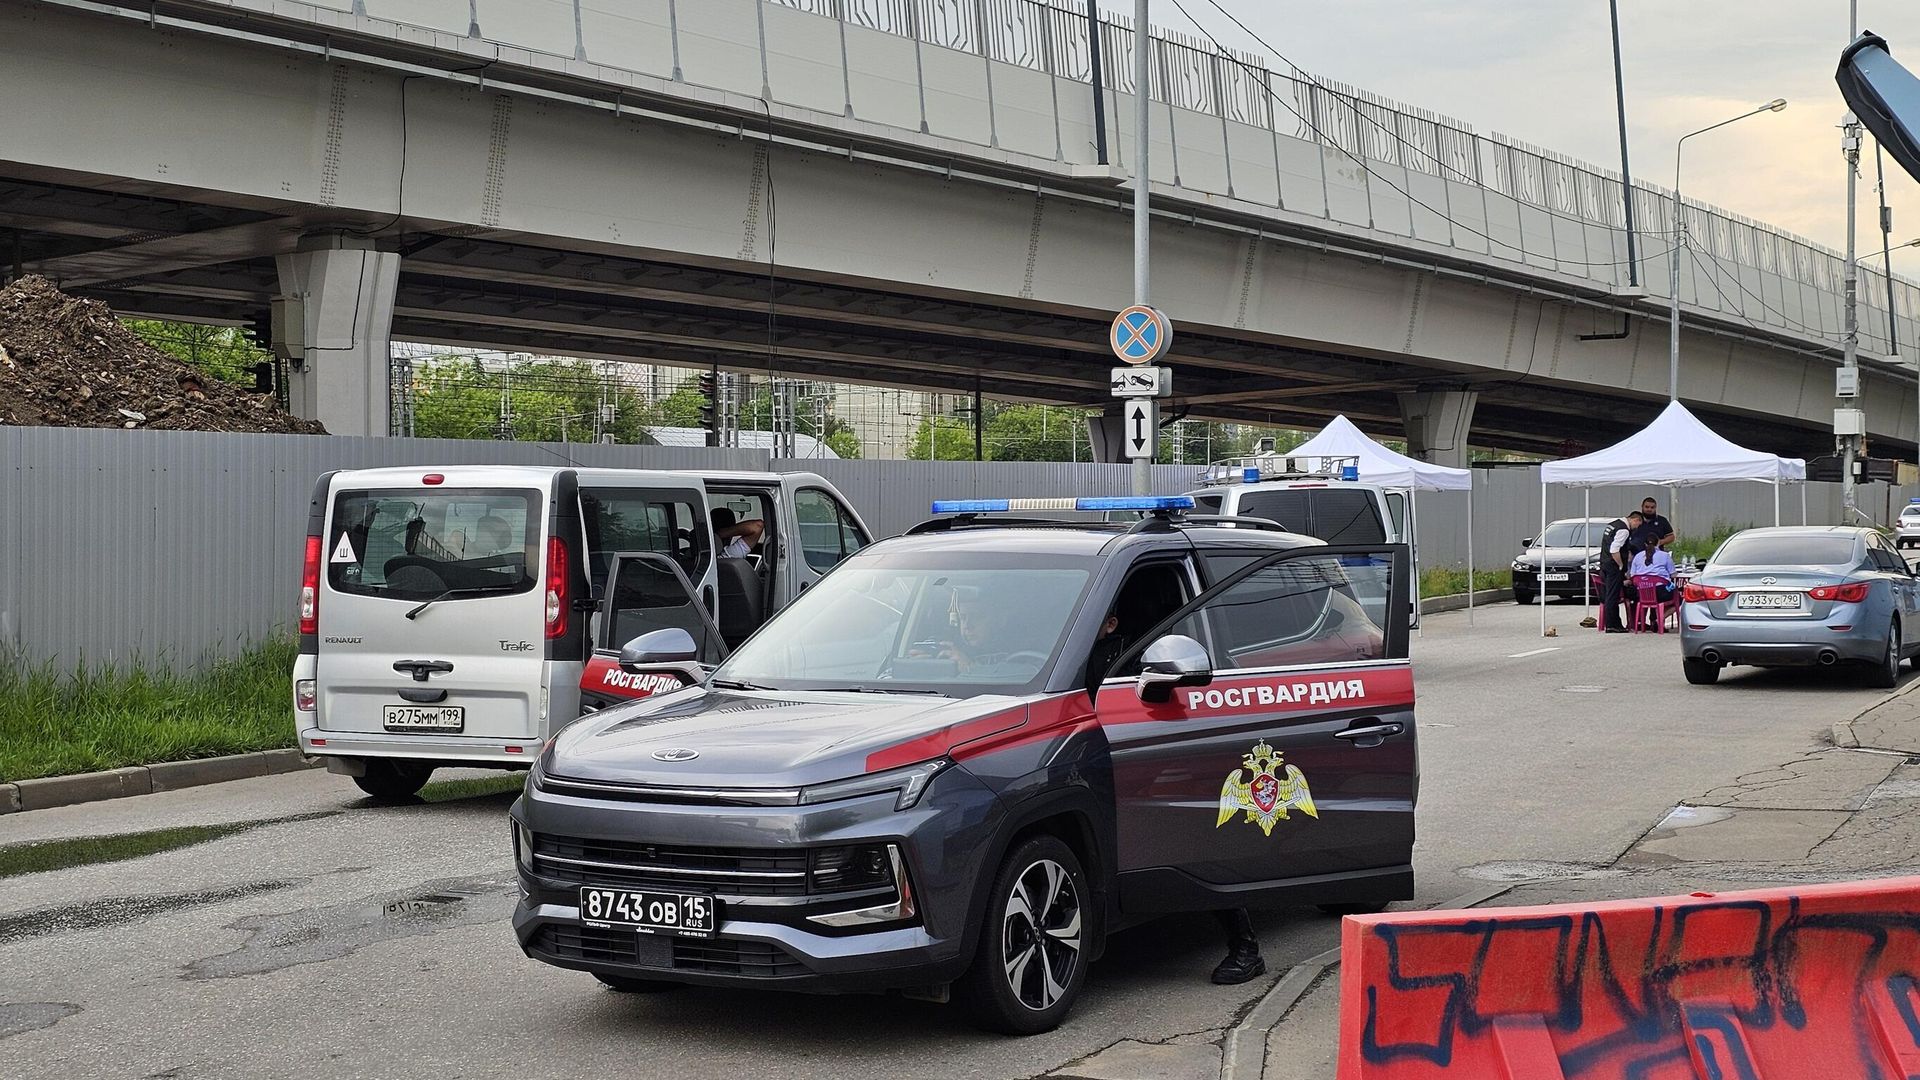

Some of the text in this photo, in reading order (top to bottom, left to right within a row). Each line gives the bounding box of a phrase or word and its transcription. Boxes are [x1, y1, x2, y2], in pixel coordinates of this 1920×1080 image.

[339, 547, 348, 558] Ш
[1741, 595, 1798, 605] У933УС 790
[325, 636, 362, 644] RENAULT
[499, 640, 535, 652] Trafic
[1188, 679, 1365, 710] РОСГВАРДИЯ
[389, 709, 459, 724] В275ММ 199
[588, 890, 705, 924] 8743 ОВ 15
[686, 918, 703, 928] RUS
